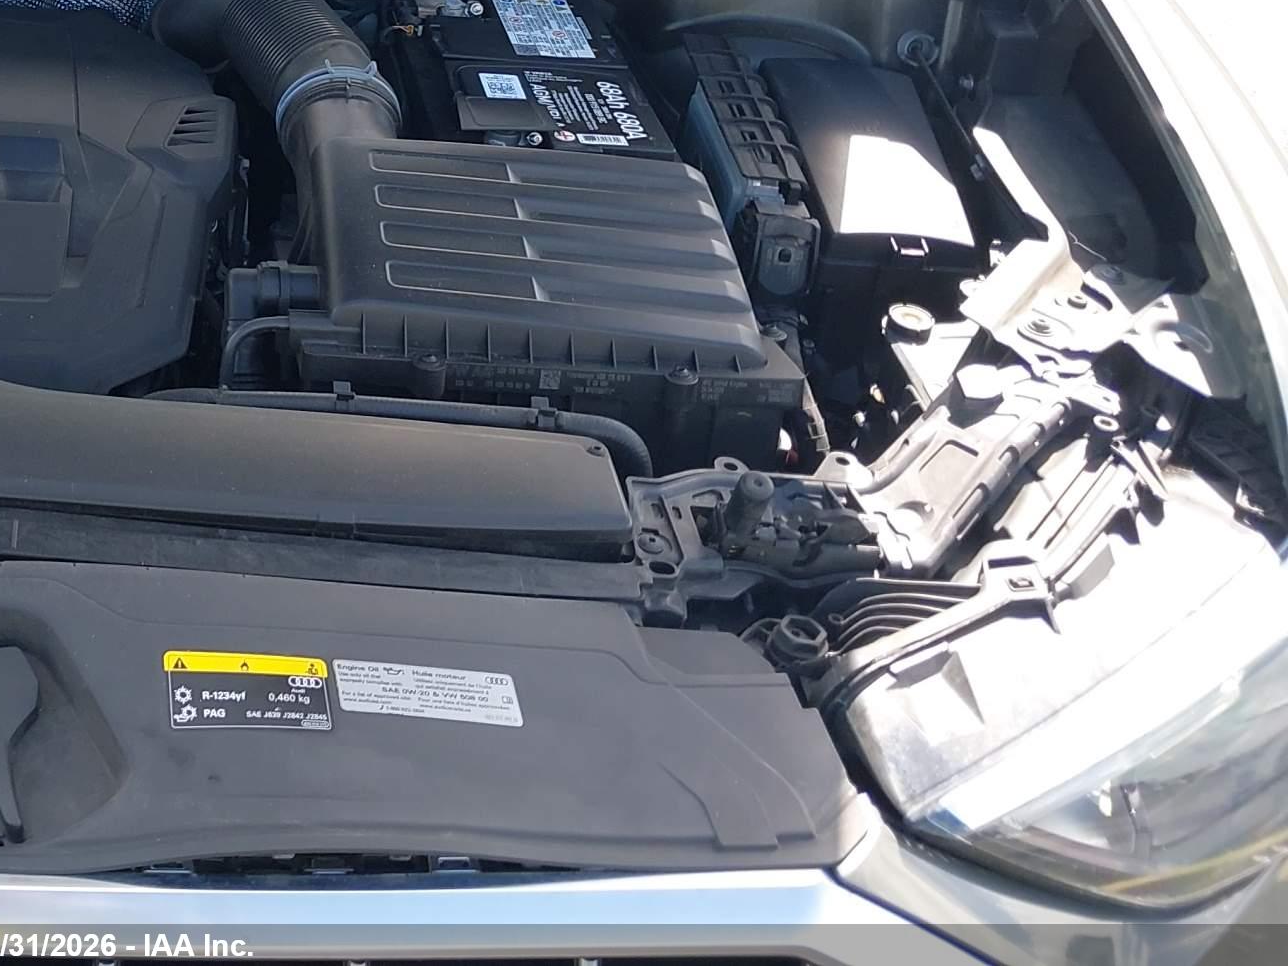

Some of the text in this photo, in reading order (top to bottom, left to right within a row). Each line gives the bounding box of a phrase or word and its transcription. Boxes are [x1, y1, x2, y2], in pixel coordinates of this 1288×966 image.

[612, 111, 648, 141] 680A
[337, 663, 380, 673] Engine Oil
[201, 690, 247, 703] R-1234yf
[268, 692, 310, 705] 0,460 kg
[203, 707, 226, 718] PAG
[245, 710, 262, 718] SAE
